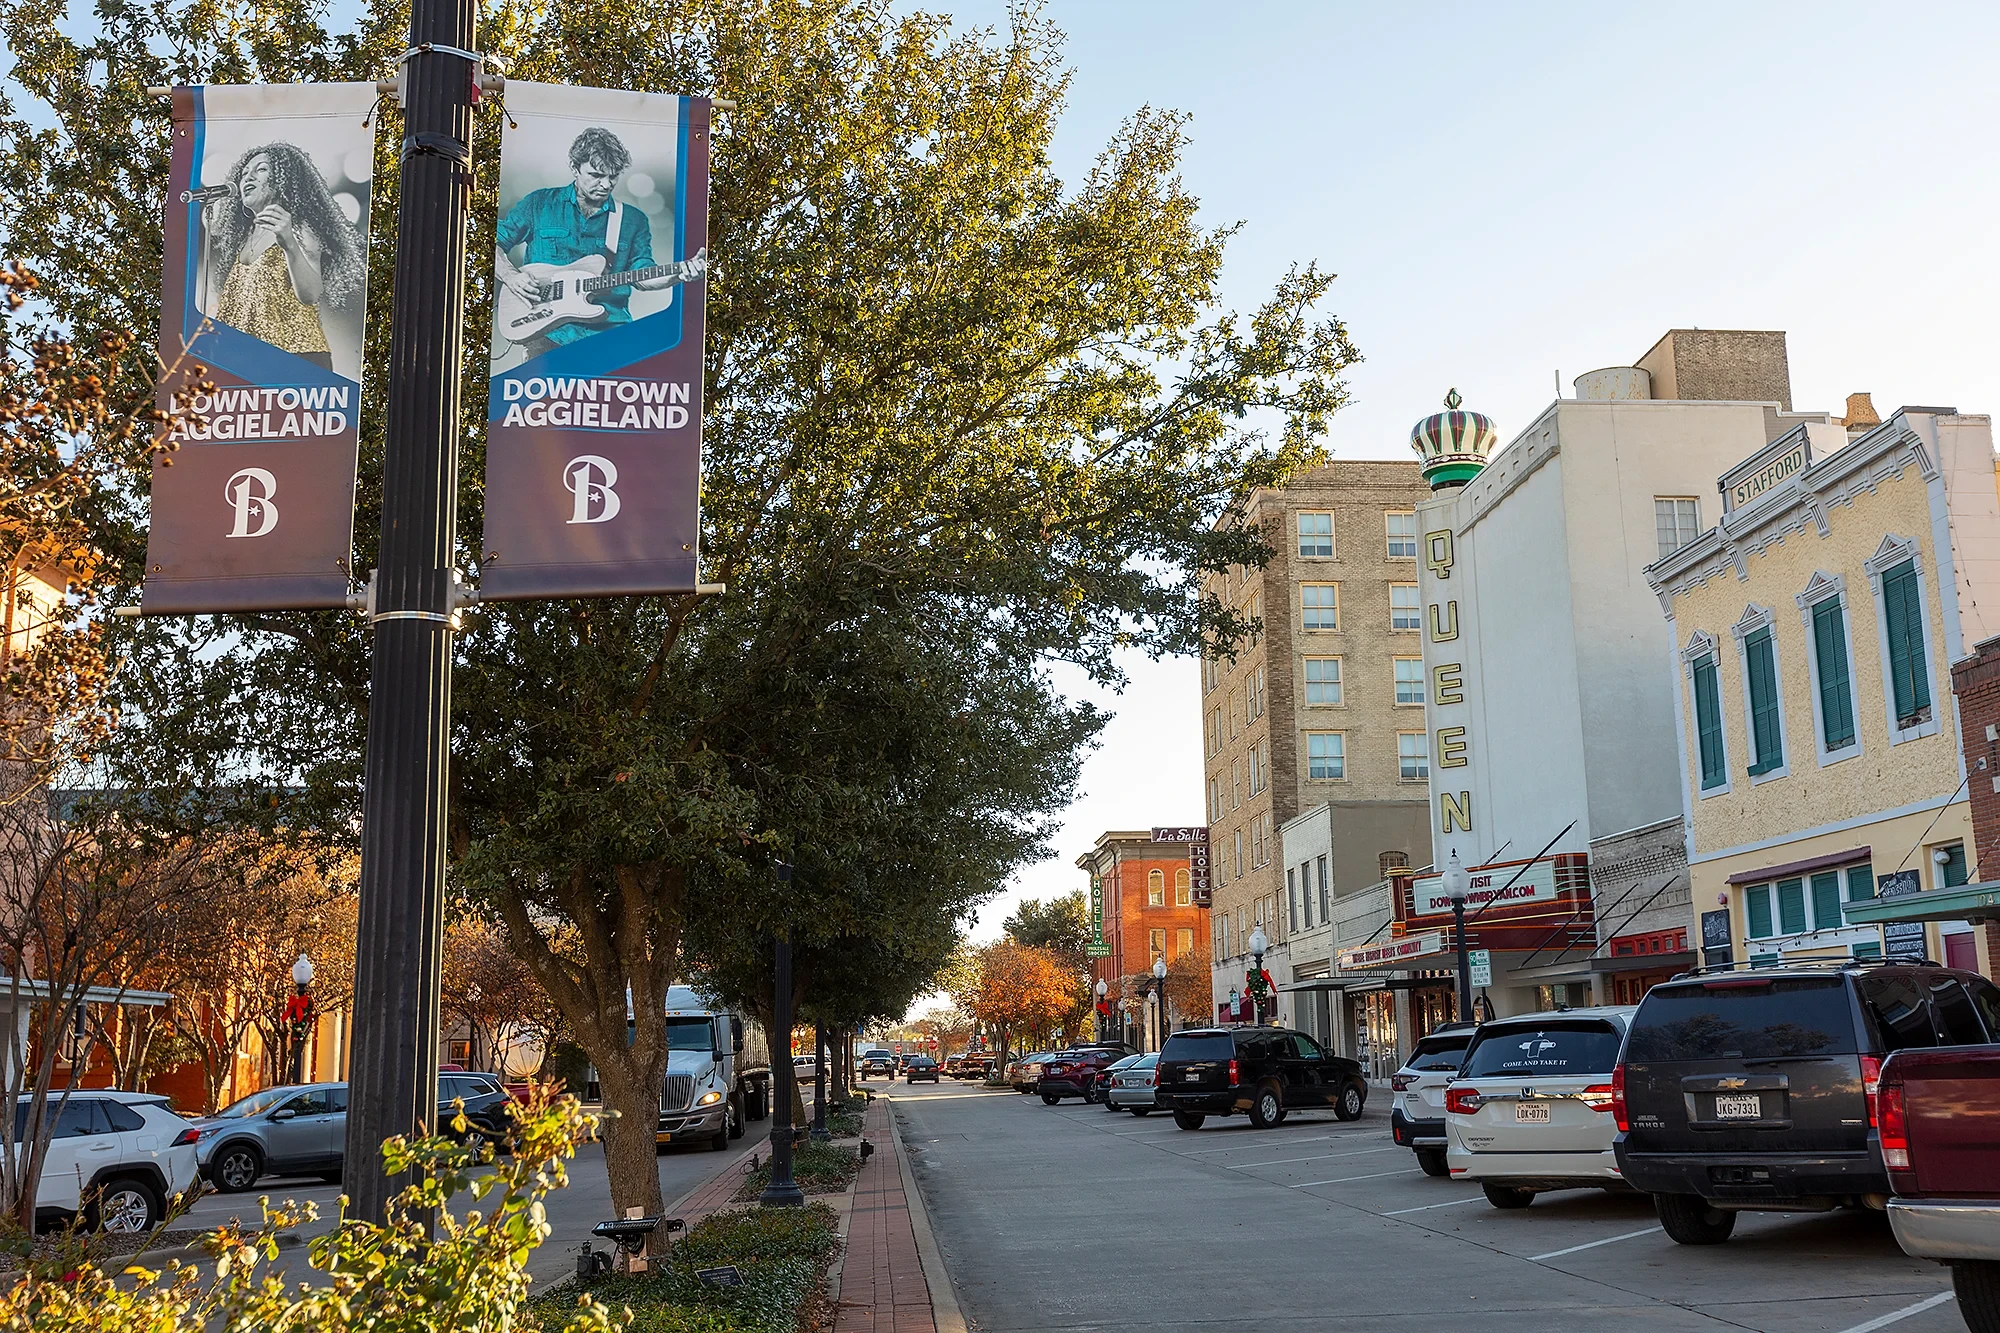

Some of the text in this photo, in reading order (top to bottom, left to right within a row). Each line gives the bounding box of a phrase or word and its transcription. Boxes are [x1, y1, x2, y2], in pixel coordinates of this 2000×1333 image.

[502, 377, 690, 404] DOWNTOWN
[167, 411, 347, 442] AGGIELAND
[502, 401, 689, 430] AGGIELAND
[563, 454, 621, 524] B
[1736, 450, 1802, 504] STAFFORD
[224, 467, 279, 538] B
[1424, 528, 1472, 834] QUEEN
[1157, 828, 1207, 842] La Salle
[1197, 846, 1207, 899] HOTEL
[1093, 880, 1101, 932] HOWELL
[1976, 893, 1994, 907] 104
[1502, 1060, 1522, 1068] COME
